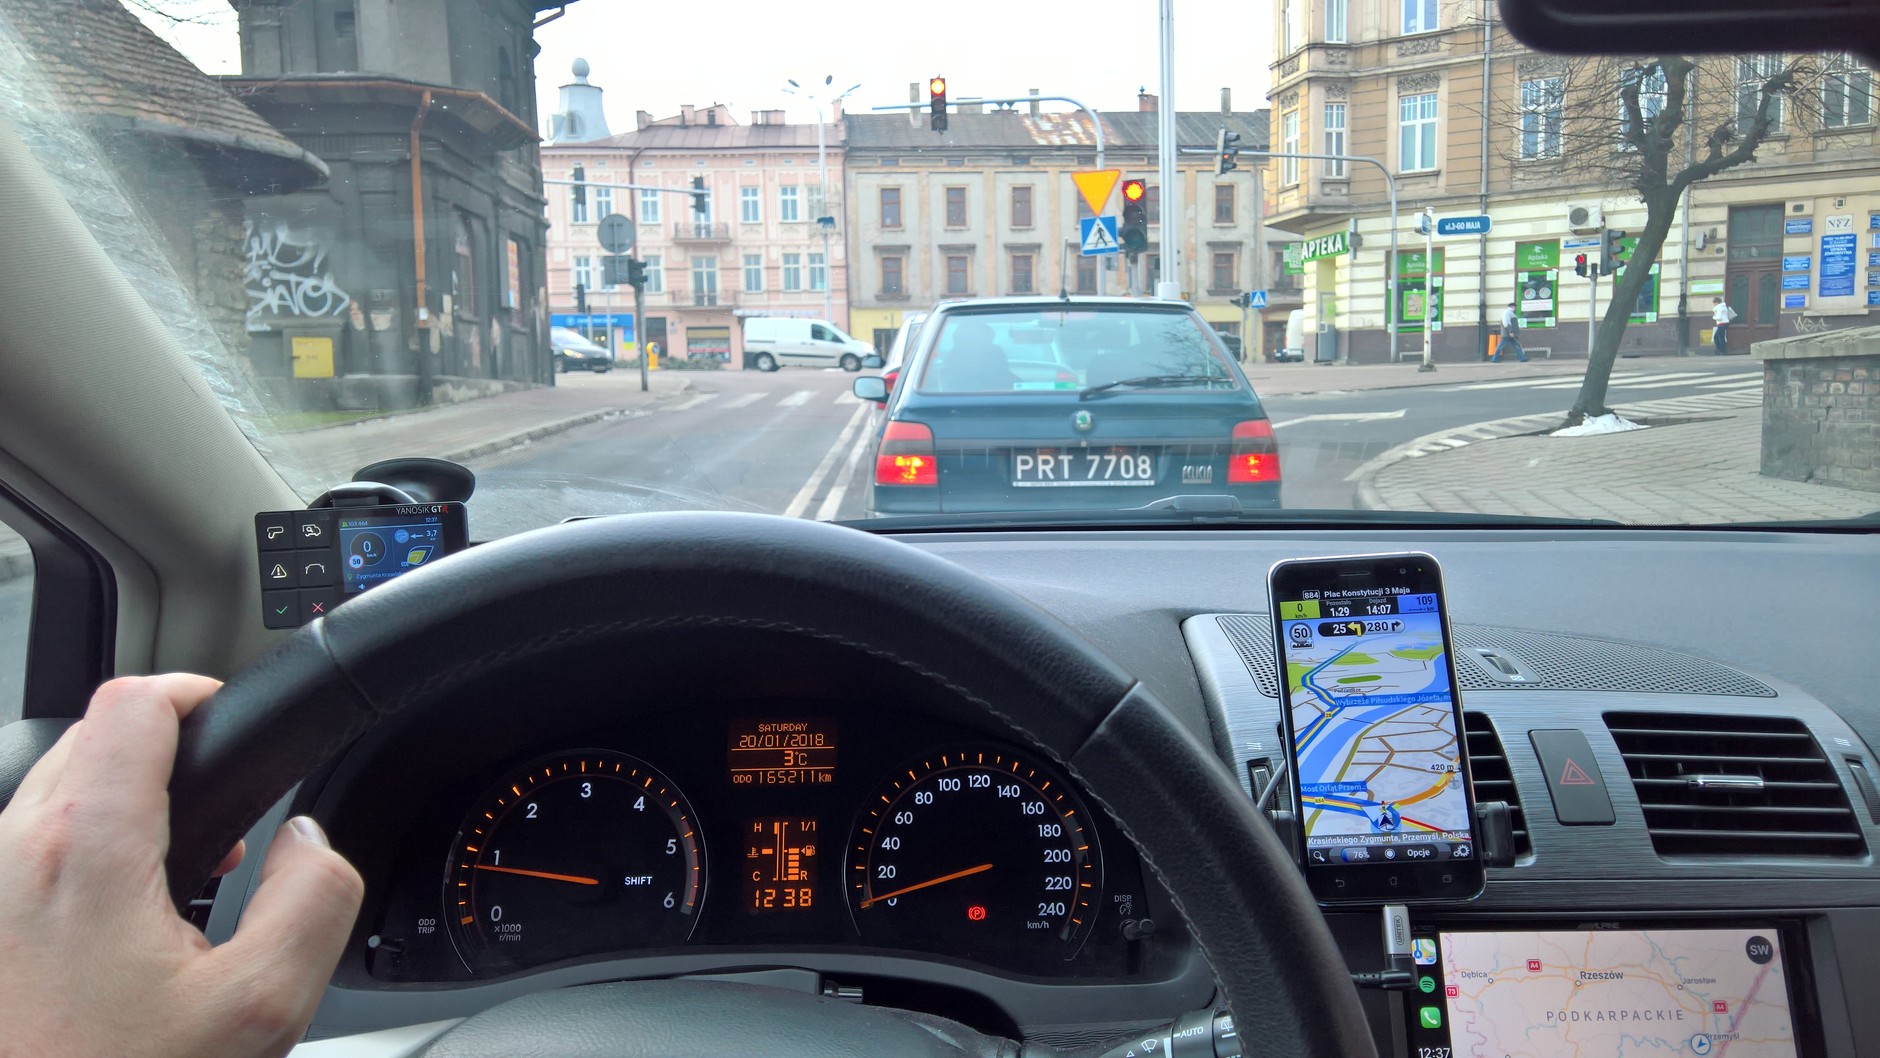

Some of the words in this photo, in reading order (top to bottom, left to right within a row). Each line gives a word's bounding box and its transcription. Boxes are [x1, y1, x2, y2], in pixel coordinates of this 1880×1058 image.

[1828, 218, 1851, 228] NFZ
[1301, 233, 1342, 260] APTEKA
[1016, 455, 1074, 480] PRT
[1086, 455, 1152, 480] 7708
[1182, 465, 1212, 479] FELICIA
[396, 506, 430, 514] YANOSIK
[431, 504, 448, 514] GTR
[363, 541, 371, 552] 0
[1342, 588, 1384, 598] Konstytucji
[1392, 587, 1410, 595] Maja
[1416, 596, 1432, 605] 109
[1297, 604, 1302, 612] 0
[1366, 604, 1391, 614] 14:07
[1294, 628, 1308, 638] 50
[1333, 624, 1346, 634] 25
[1368, 622, 1388, 632] 280
[758, 724, 807, 732] SATURDAY
[740, 734, 824, 748] 20/01/2018
[733, 775, 752, 784] ODO
[760, 770, 814, 784] 165211
[818, 771, 832, 783] km
[968, 774, 990, 788] 120
[580, 782, 592, 798] 3
[938, 778, 960, 792] 100
[997, 784, 1020, 798] 140
[633, 796, 645, 812] 4
[915, 792, 933, 805] 80
[526, 802, 538, 819] 2
[1021, 802, 1044, 815] 160
[895, 812, 913, 825] 60
[754, 822, 762, 832] H
[801, 821, 816, 831] 1/1
[1038, 824, 1061, 838] 180
[881, 837, 900, 850] 40
[1308, 836, 1358, 845] Krasińskiego
[666, 839, 677, 855] 5
[1407, 848, 1430, 858] Opcje
[493, 850, 500, 866] 1
[1044, 849, 1071, 863] 200
[1353, 851, 1370, 859] 76%
[752, 871, 760, 881] C
[800, 871, 808, 880] R
[878, 866, 896, 879] 20
[624, 876, 652, 886] SHIFT
[1045, 877, 1072, 890] 220
[663, 892, 674, 908] 6
[491, 906, 502, 922] 0
[1038, 902, 1066, 916] 240
[1027, 920, 1050, 930] km/h
[1750, 944, 1769, 956] SW
[1461, 971, 1487, 980] Dębica
[1580, 970, 1624, 980] Rzeszów
[1682, 977, 1716, 985] Jarosław
[1547, 1010, 1684, 1022] PODKARPACKIE
[1180, 1026, 1204, 1038] AUTO
[1418, 1048, 1450, 1058] 12:37
